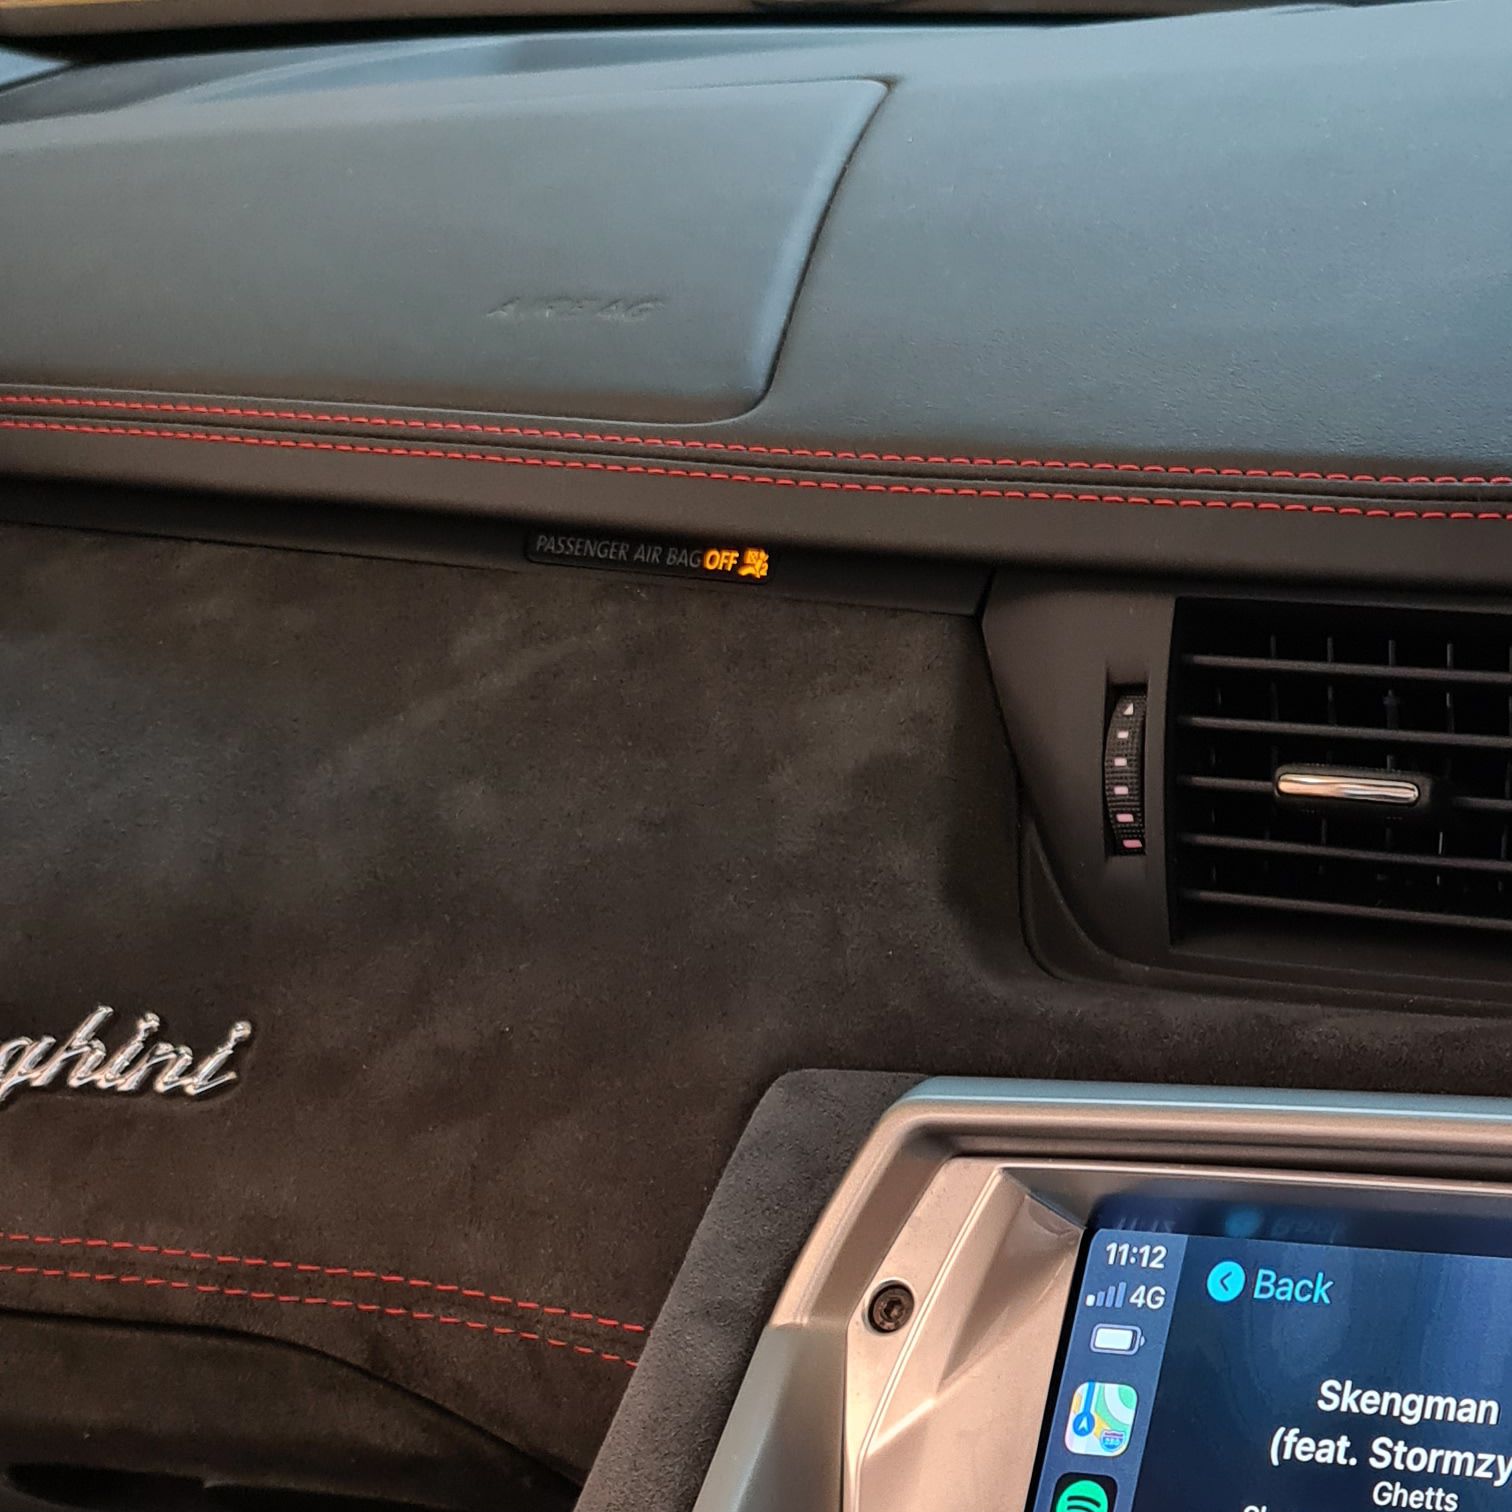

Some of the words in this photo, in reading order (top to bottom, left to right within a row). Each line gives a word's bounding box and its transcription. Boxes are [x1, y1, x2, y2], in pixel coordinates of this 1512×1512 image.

[536, 535, 628, 560] PASSENGER
[633, 544, 661, 565] AIR
[666, 547, 701, 568] BAG
[704, 548, 739, 572] OFF
[1105, 1242, 1168, 1269] 11:12
[1129, 1285, 1166, 1310] 4G
[1253, 1268, 1334, 1305] Back
[1316, 1379, 1500, 1426] Skengman
[1269, 1426, 1358, 1467] (feat.
[1372, 1481, 1459, 1512] Ghetts
